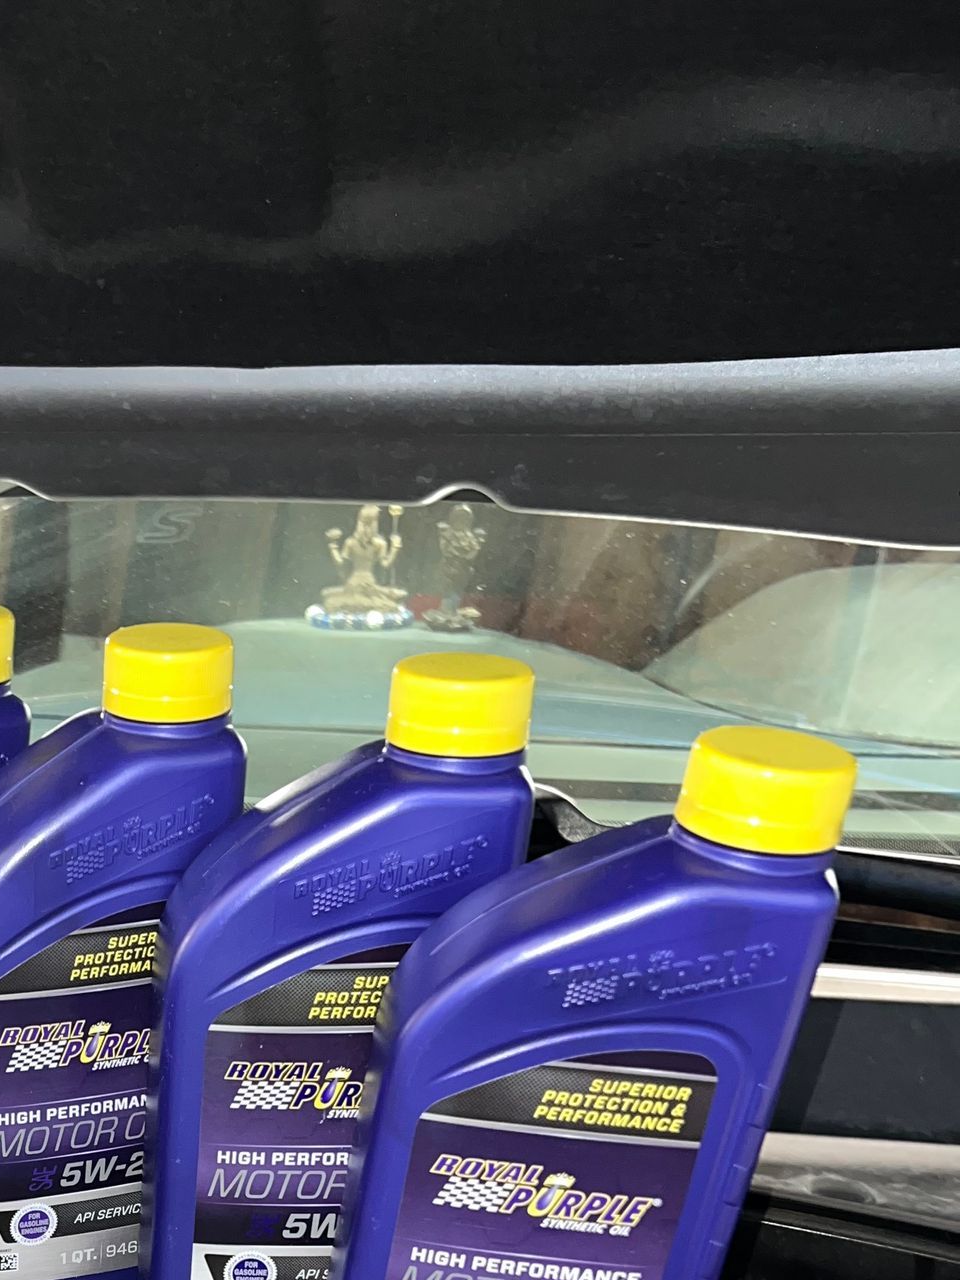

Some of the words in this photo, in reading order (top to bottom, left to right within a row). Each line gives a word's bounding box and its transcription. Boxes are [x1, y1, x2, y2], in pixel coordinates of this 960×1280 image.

[313, 991, 382, 1004] PROTEC
[308, 1006, 376, 1019] PERFOR
[92, 1055, 141, 1071] SYNTHETIC
[224, 1061, 323, 1081] ROYAL
[589, 1078, 692, 1102] SUPERIOR
[541, 1089, 669, 1115] PROTECTION
[671, 1103, 687, 1117] &
[533, 1105, 685, 1133] PERFORMANCE
[216, 1150, 265, 1166] HIGH
[271, 1152, 349, 1166] PERFOR
[430, 1154, 544, 1187] ROYAL
[499, 1184, 655, 1228] PURPLE
[19, 1218, 49, 1229] GASOLINE
[28, 1212, 41, 1220] FOR
[74, 1211, 94, 1224] API
[540, 1218, 607, 1236] SYNTHETIC
[609, 1225, 631, 1237] OIL
[60, 1252, 67, 1265] 1
[71, 1248, 98, 1264] QT.
[106, 1240, 138, 1258] 946
[410, 1247, 466, 1271] HIGH
[234, 1268, 268, 1277] GASOLINE
[244, 1261, 258, 1269] FOR
[295, 1269, 319, 1280] API
